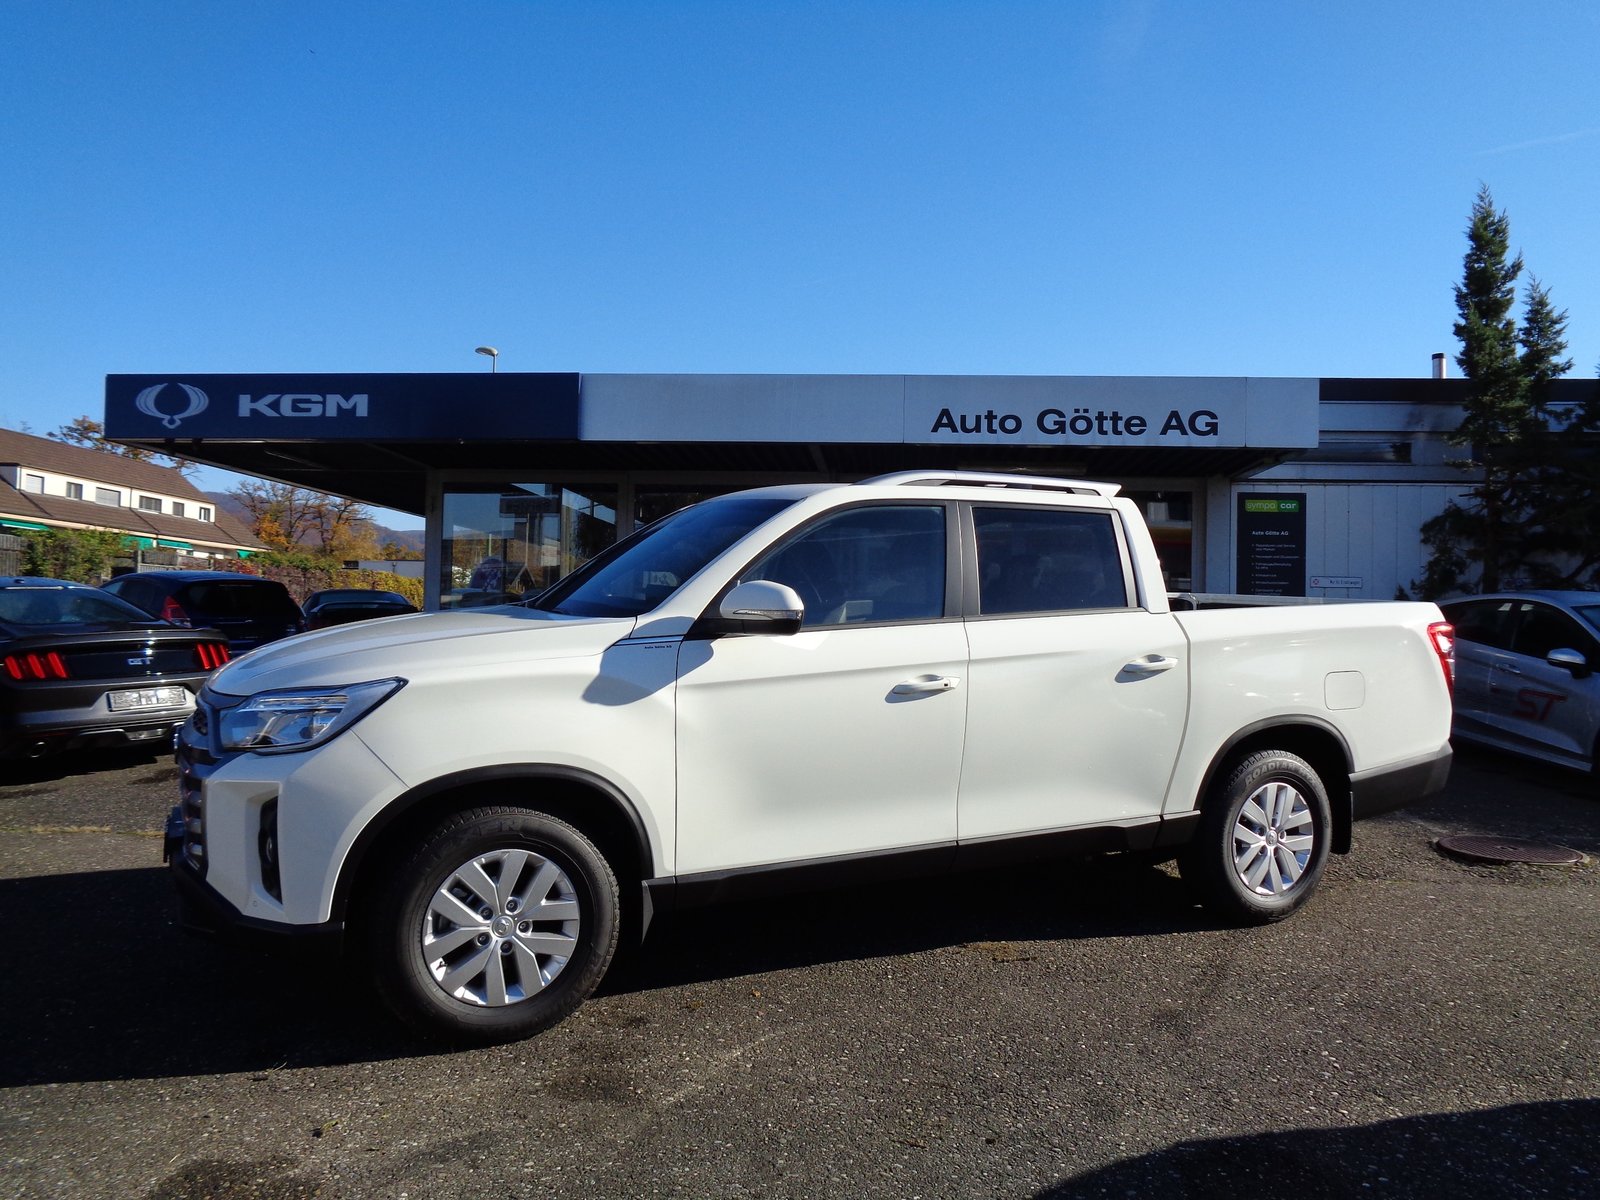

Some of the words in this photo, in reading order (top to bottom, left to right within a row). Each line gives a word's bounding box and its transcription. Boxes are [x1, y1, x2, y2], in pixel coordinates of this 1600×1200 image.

[238, 394, 369, 417] KGM
[931, 408, 1022, 434] Auto
[1036, 408, 1147, 436] Götte
[1159, 410, 1219, 437] AG
[1247, 502, 1276, 510] sympa
[1512, 689, 1568, 721] ST
